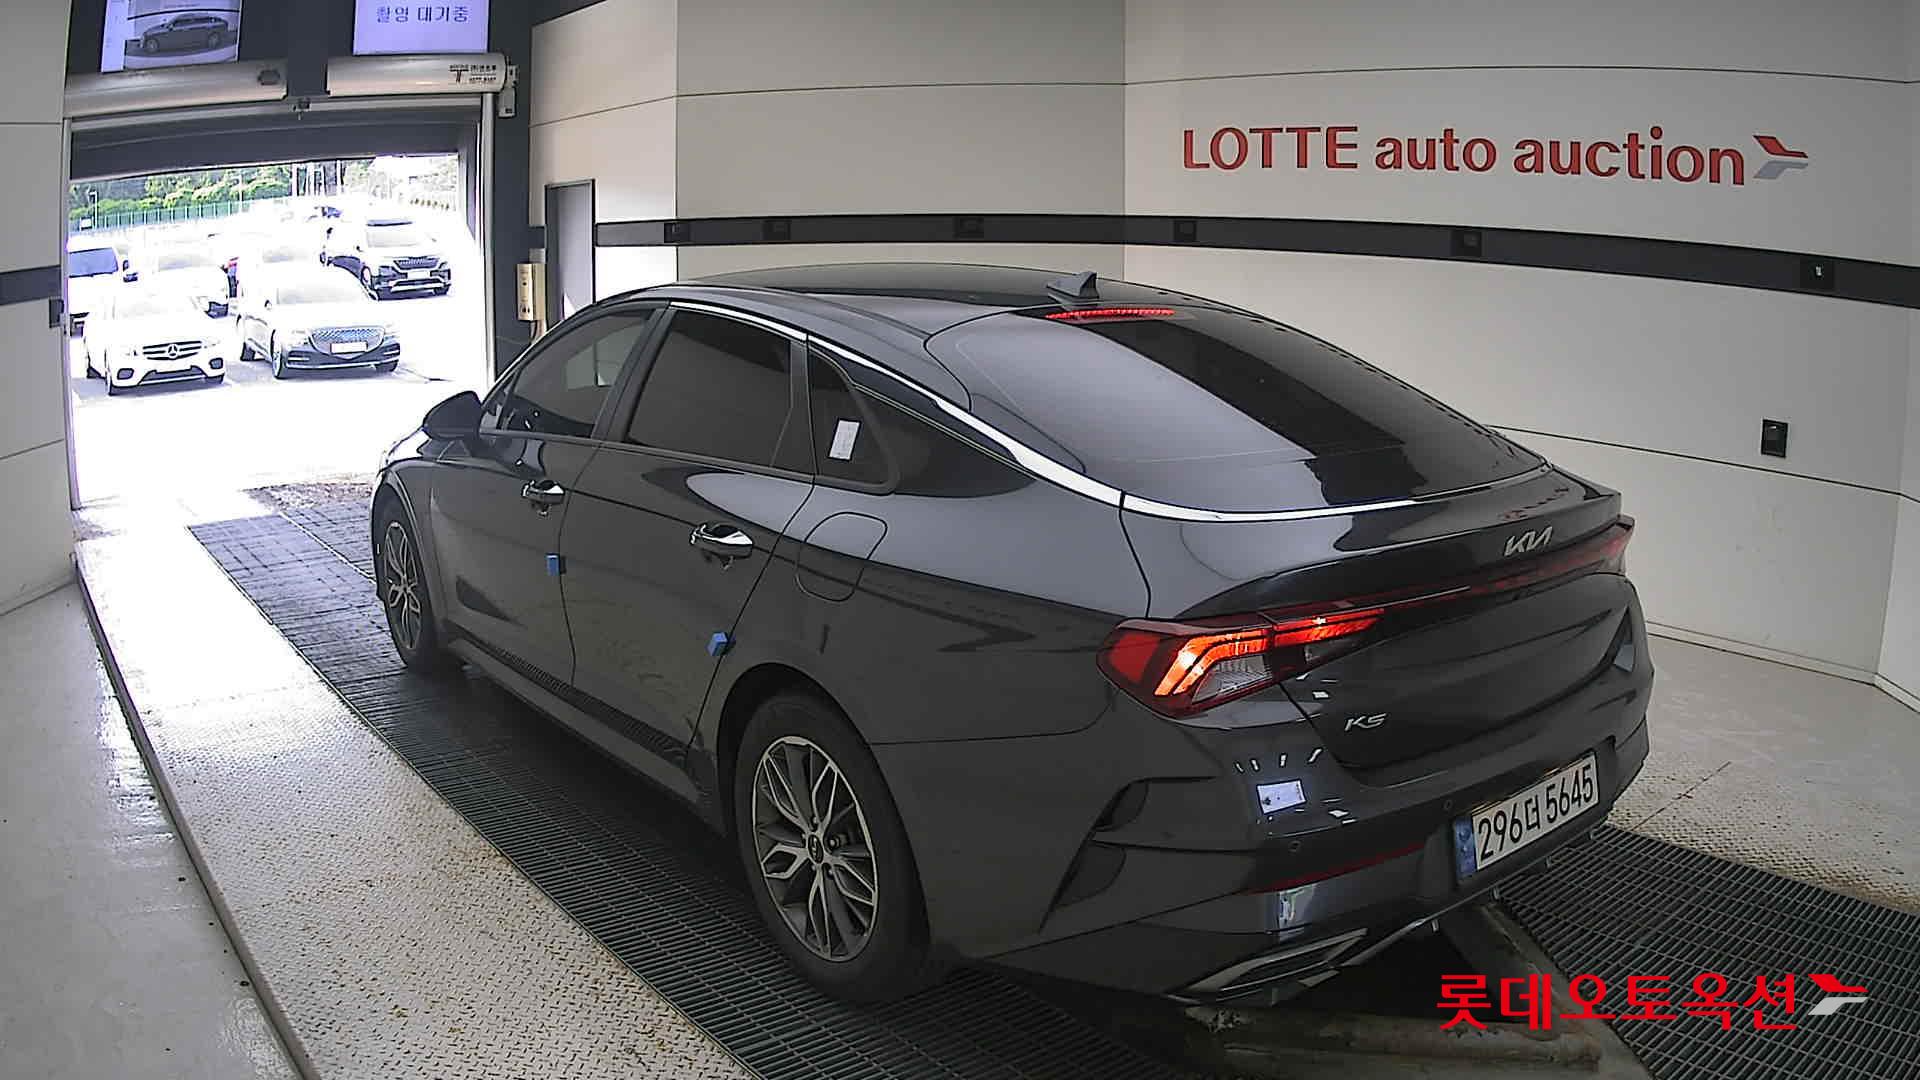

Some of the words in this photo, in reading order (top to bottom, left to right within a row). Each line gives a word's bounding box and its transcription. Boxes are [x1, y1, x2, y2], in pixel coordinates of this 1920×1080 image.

[417, 4, 469, 23] 대기중
[1183, 125, 1358, 170] LOTTE
[1374, 128, 1498, 174] auto
[1512, 126, 1745, 186] auction
[1344, 712, 1387, 732] K5
[1479, 795, 1540, 861] 296더
[1546, 764, 1594, 824] 5645
